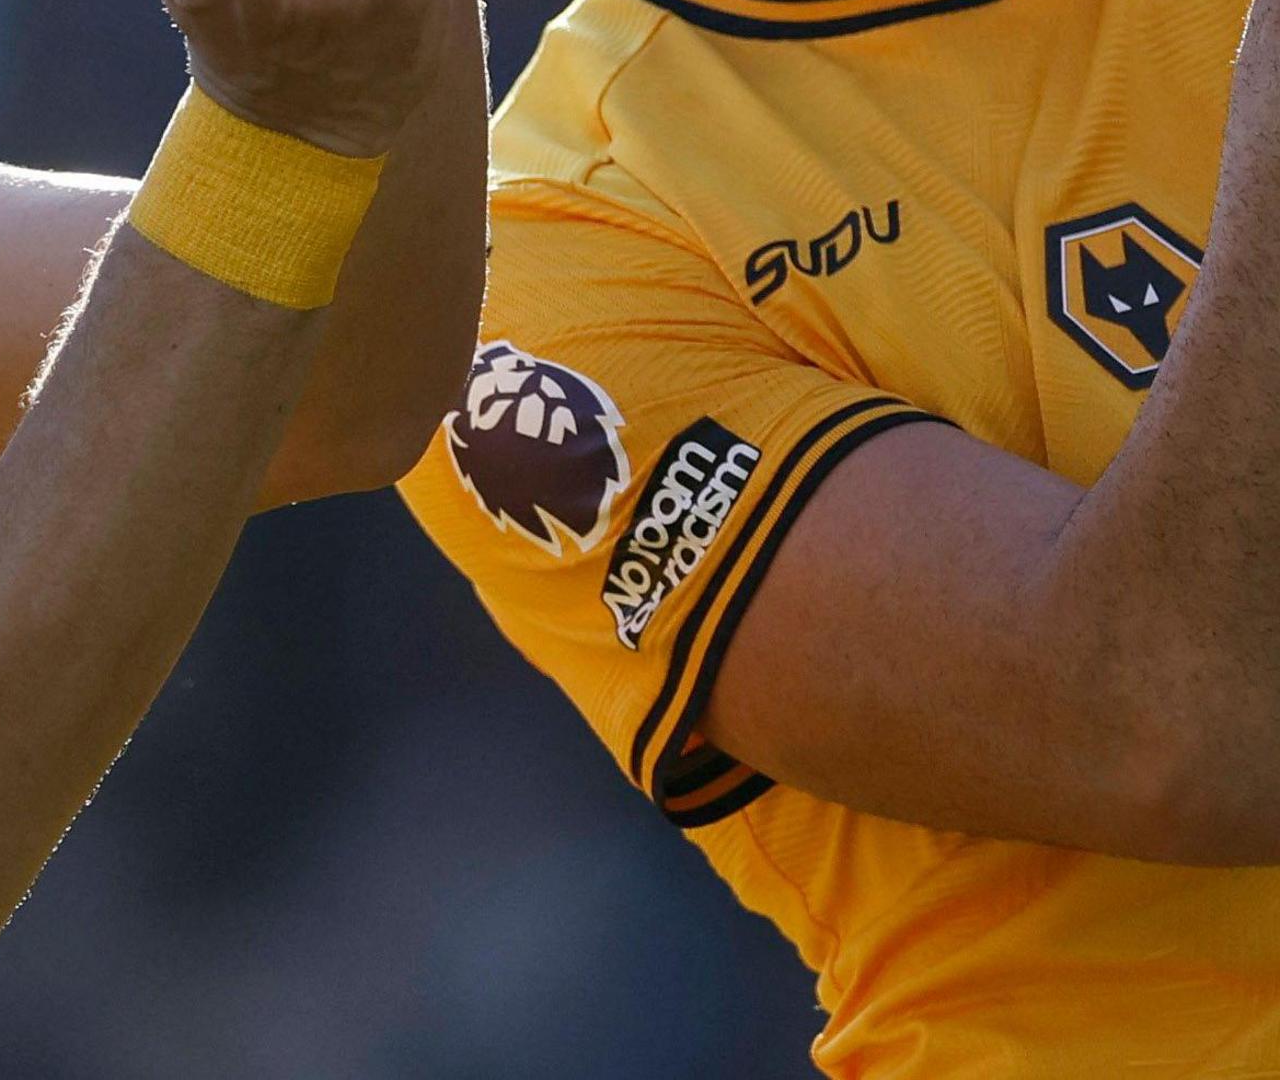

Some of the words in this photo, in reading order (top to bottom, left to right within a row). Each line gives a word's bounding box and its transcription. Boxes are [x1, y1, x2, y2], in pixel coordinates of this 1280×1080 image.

[744, 199, 900, 306] SUDU
[603, 560, 652, 623] No
[629, 441, 718, 565] room
[617, 580, 666, 650] for
[663, 443, 761, 588] racism
